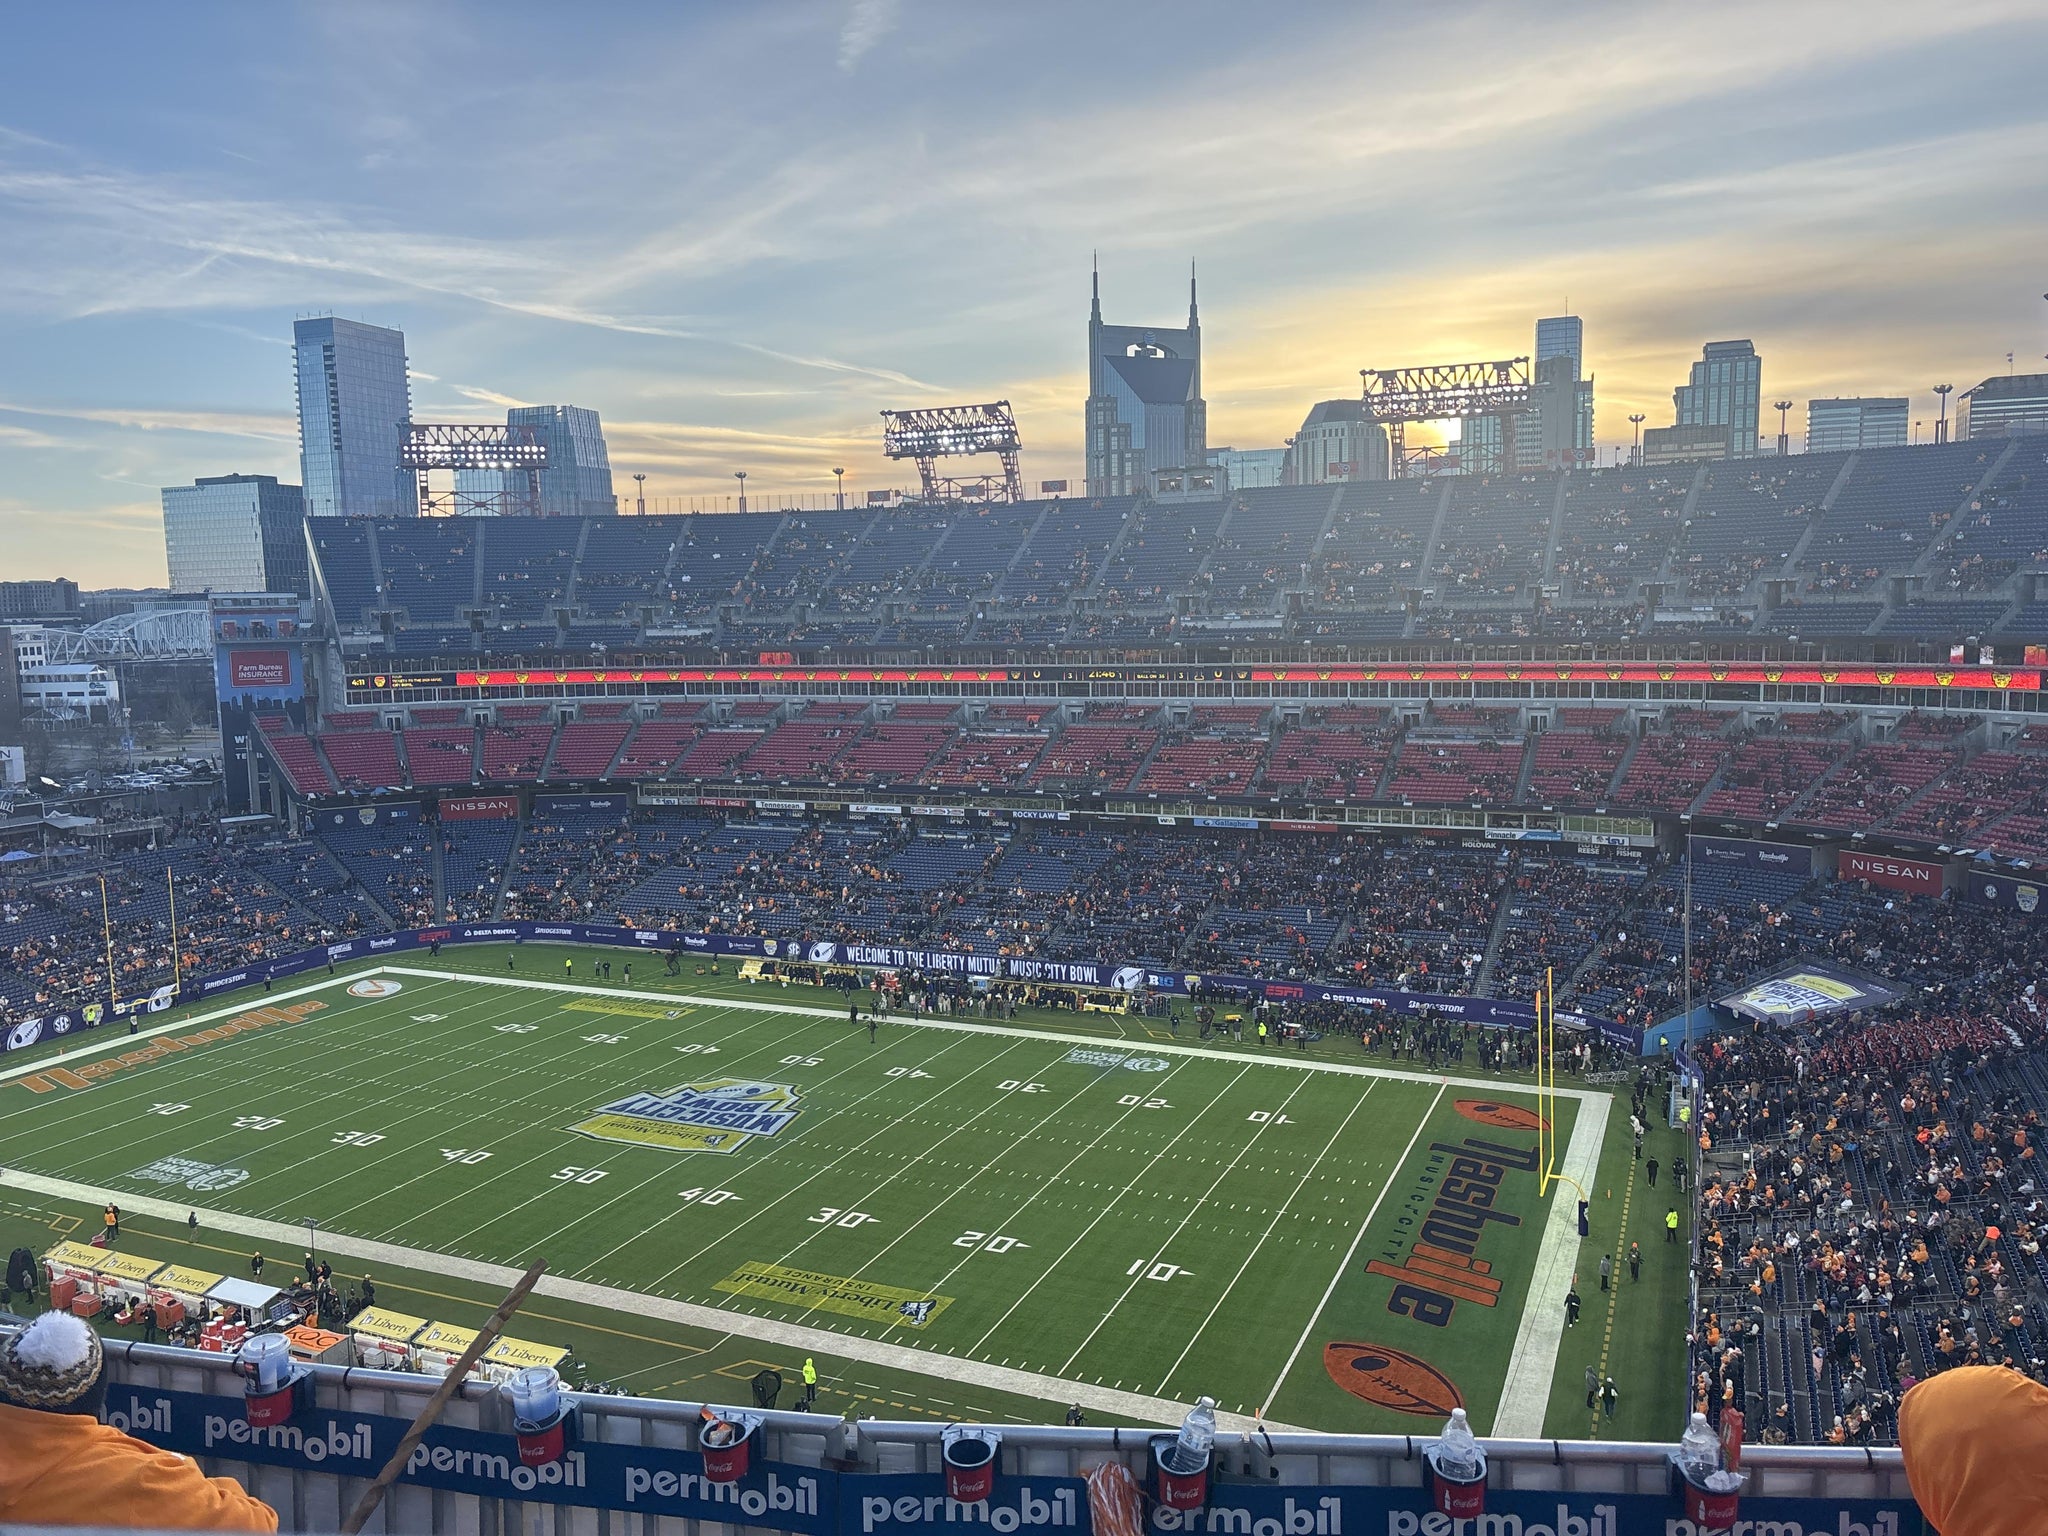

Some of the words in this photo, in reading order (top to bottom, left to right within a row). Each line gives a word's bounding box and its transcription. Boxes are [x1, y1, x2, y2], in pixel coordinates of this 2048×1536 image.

[450, 801, 508, 811] NISSAN
[1013, 810, 1037, 818] ROCKY
[1215, 819, 1250, 828] Gallagher
[1486, 830, 1517, 839] Pinnacle
[1616, 850, 1642, 858] FISHER
[1852, 859, 1928, 880] NISSAN
[419, 930, 450, 942] ESPN
[847, 946, 890, 964] WELCOME
[892, 948, 904, 966] TO
[906, 949, 924, 968] THE
[927, 952, 964, 972] LIBERTY
[1010, 959, 1042, 979] MUSIC
[1044, 963, 1068, 982] CITY
[1070, 964, 1100, 984] BOWL
[204, 972, 247, 990] BRIDGESTONE
[1266, 984, 1304, 998] ESPN
[1332, 994, 1354, 1004] DELTA
[1356, 997, 1387, 1006] DENTAL
[54, 1016, 70, 1032] SEC
[413, 1014, 448, 1022] 10
[495, 1024, 538, 1034] 20
[585, 1034, 628, 1044] 30
[1, 1000, 329, 1094] Nashville
[679, 1044, 720, 1055] 40
[778, 1054, 824, 1067] 50
[883, 1066, 929, 1079] 40
[996, 1080, 1045, 1094] 30
[148, 1102, 192, 1116] 10
[606, 1096, 684, 1119] CITY
[677, 1092, 767, 1112] BOWL
[1116, 1094, 1169, 1109] 20
[231, 1115, 286, 1130] 20
[680, 1109, 786, 1132] MUSIC
[1246, 1110, 1290, 1125] 10
[602, 1121, 649, 1134] Mutual
[636, 1120, 689, 1131] INSURANCE
[330, 1130, 386, 1146] 30
[652, 1128, 701, 1141] Liberty
[163, 1157, 215, 1170] SEASON
[440, 1149, 494, 1164] 40
[150, 1162, 202, 1176] BOWL
[550, 1166, 610, 1184] 50
[1410, 1153, 1444, 1203] MUSIC
[678, 1187, 732, 1205] 40
[806, 1207, 870, 1228] 30
[1364, 1138, 1544, 1328] Nashville
[1382, 1216, 1413, 1261] CITY
[952, 1231, 1019, 1253] 20
[66, 1250, 96, 1264] Liberty
[116, 1259, 147, 1276] Liberty
[1126, 1259, 1181, 1282] 10
[174, 1272, 206, 1290] Liberty
[733, 1272, 814, 1295] Mutual
[782, 1270, 872, 1291] INSURANCE
[816, 1287, 896, 1311] Liberty
[373, 1318, 410, 1334] Liberty
[203, 1339, 211, 1350] G
[440, 1333, 474, 1347] Liber
[509, 1348, 550, 1364] Liberty
[205, 1415, 372, 1462] permobil
[408, 1442, 586, 1491] permobil
[626, 1467, 818, 1516] permobil
[958, 1479, 986, 1494] Coca-Cola
[1173, 1487, 1200, 1500] Coca-Cola
[862, 1487, 1076, 1533] permobil
[1452, 1496, 1480, 1511] Coca-Cola
[1152, 1497, 1341, 1536] ermobil
[1388, 1504, 1617, 1536] permobil
